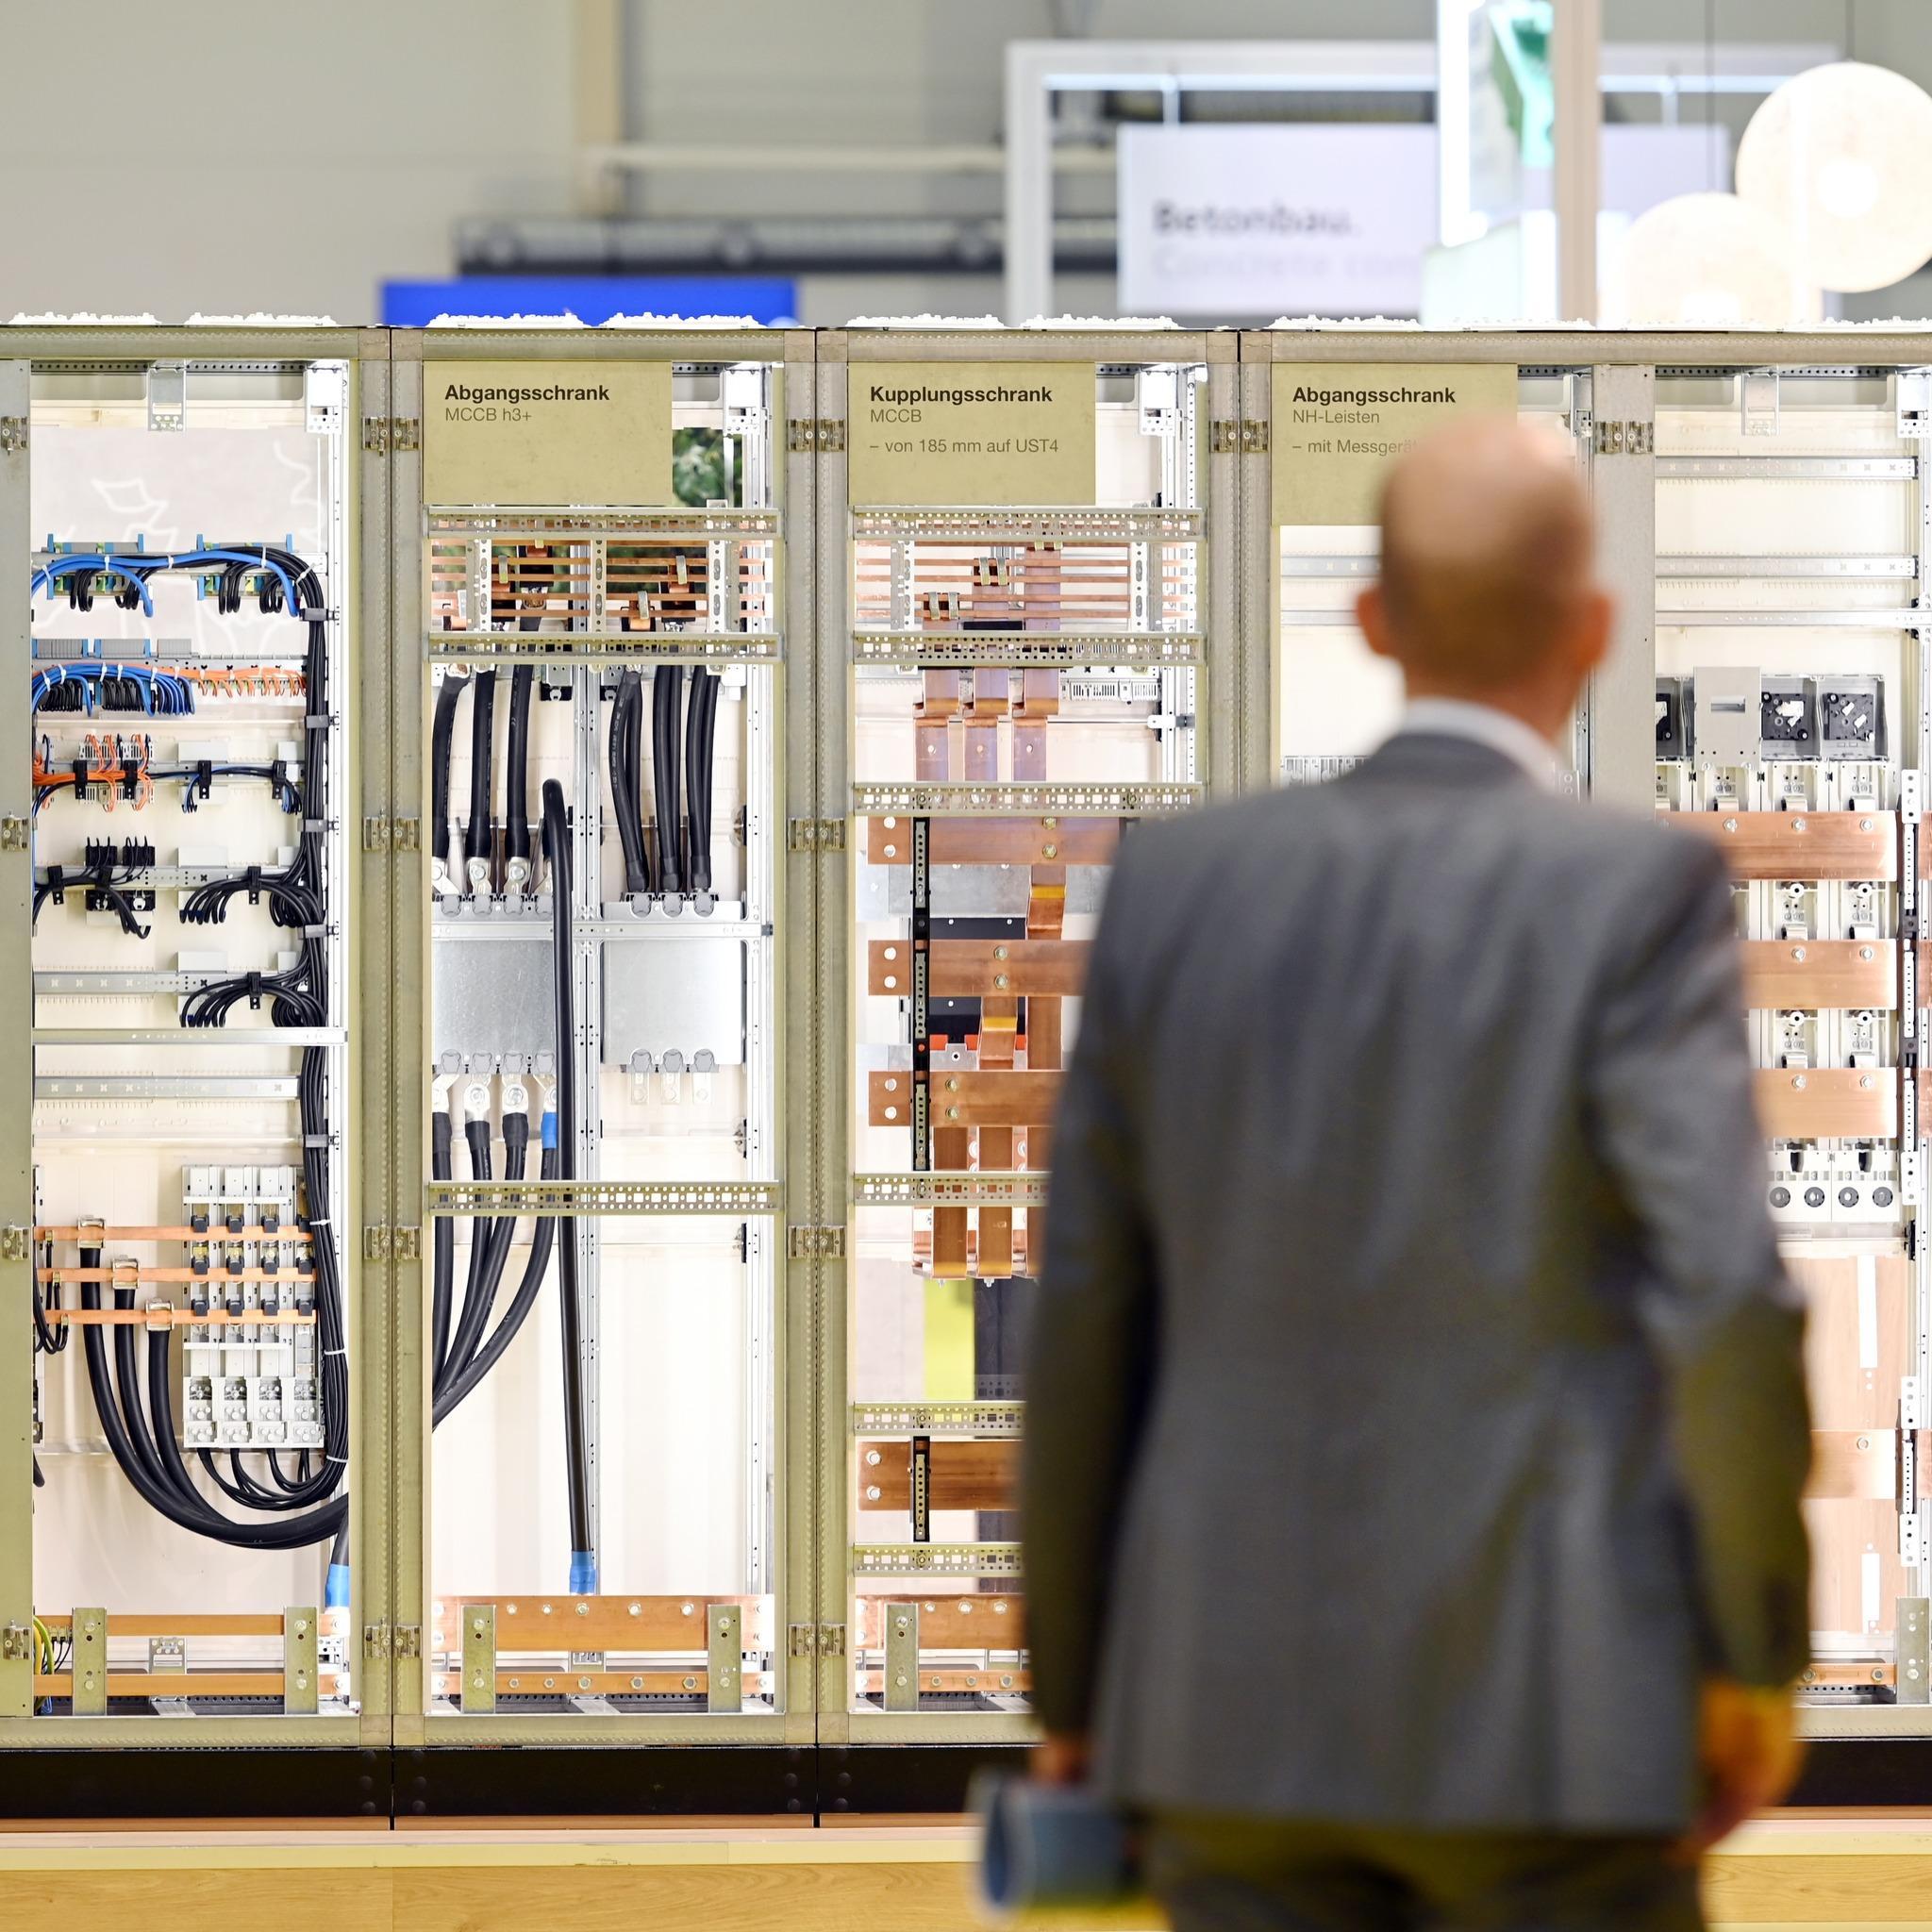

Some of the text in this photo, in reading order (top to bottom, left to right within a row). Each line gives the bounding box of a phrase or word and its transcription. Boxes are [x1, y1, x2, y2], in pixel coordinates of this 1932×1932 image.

[445, 384, 609, 405] Abgangsschrank
[870, 385, 1053, 406] Kupplungsschrank
[1292, 387, 1456, 407] Abgangsschrank
[445, 407, 532, 422] MCCB h3+
[870, 408, 922, 424] MCCB
[1292, 408, 1380, 424] NH-Leisten
[885, 441, 913, 453] von
[919, 439, 947, 453] 185
[953, 441, 981, 453] mm
[987, 438, 1011, 453] auf
[1016, 438, 1058, 453] UST4
[1308, 439, 1332, 453] mit
